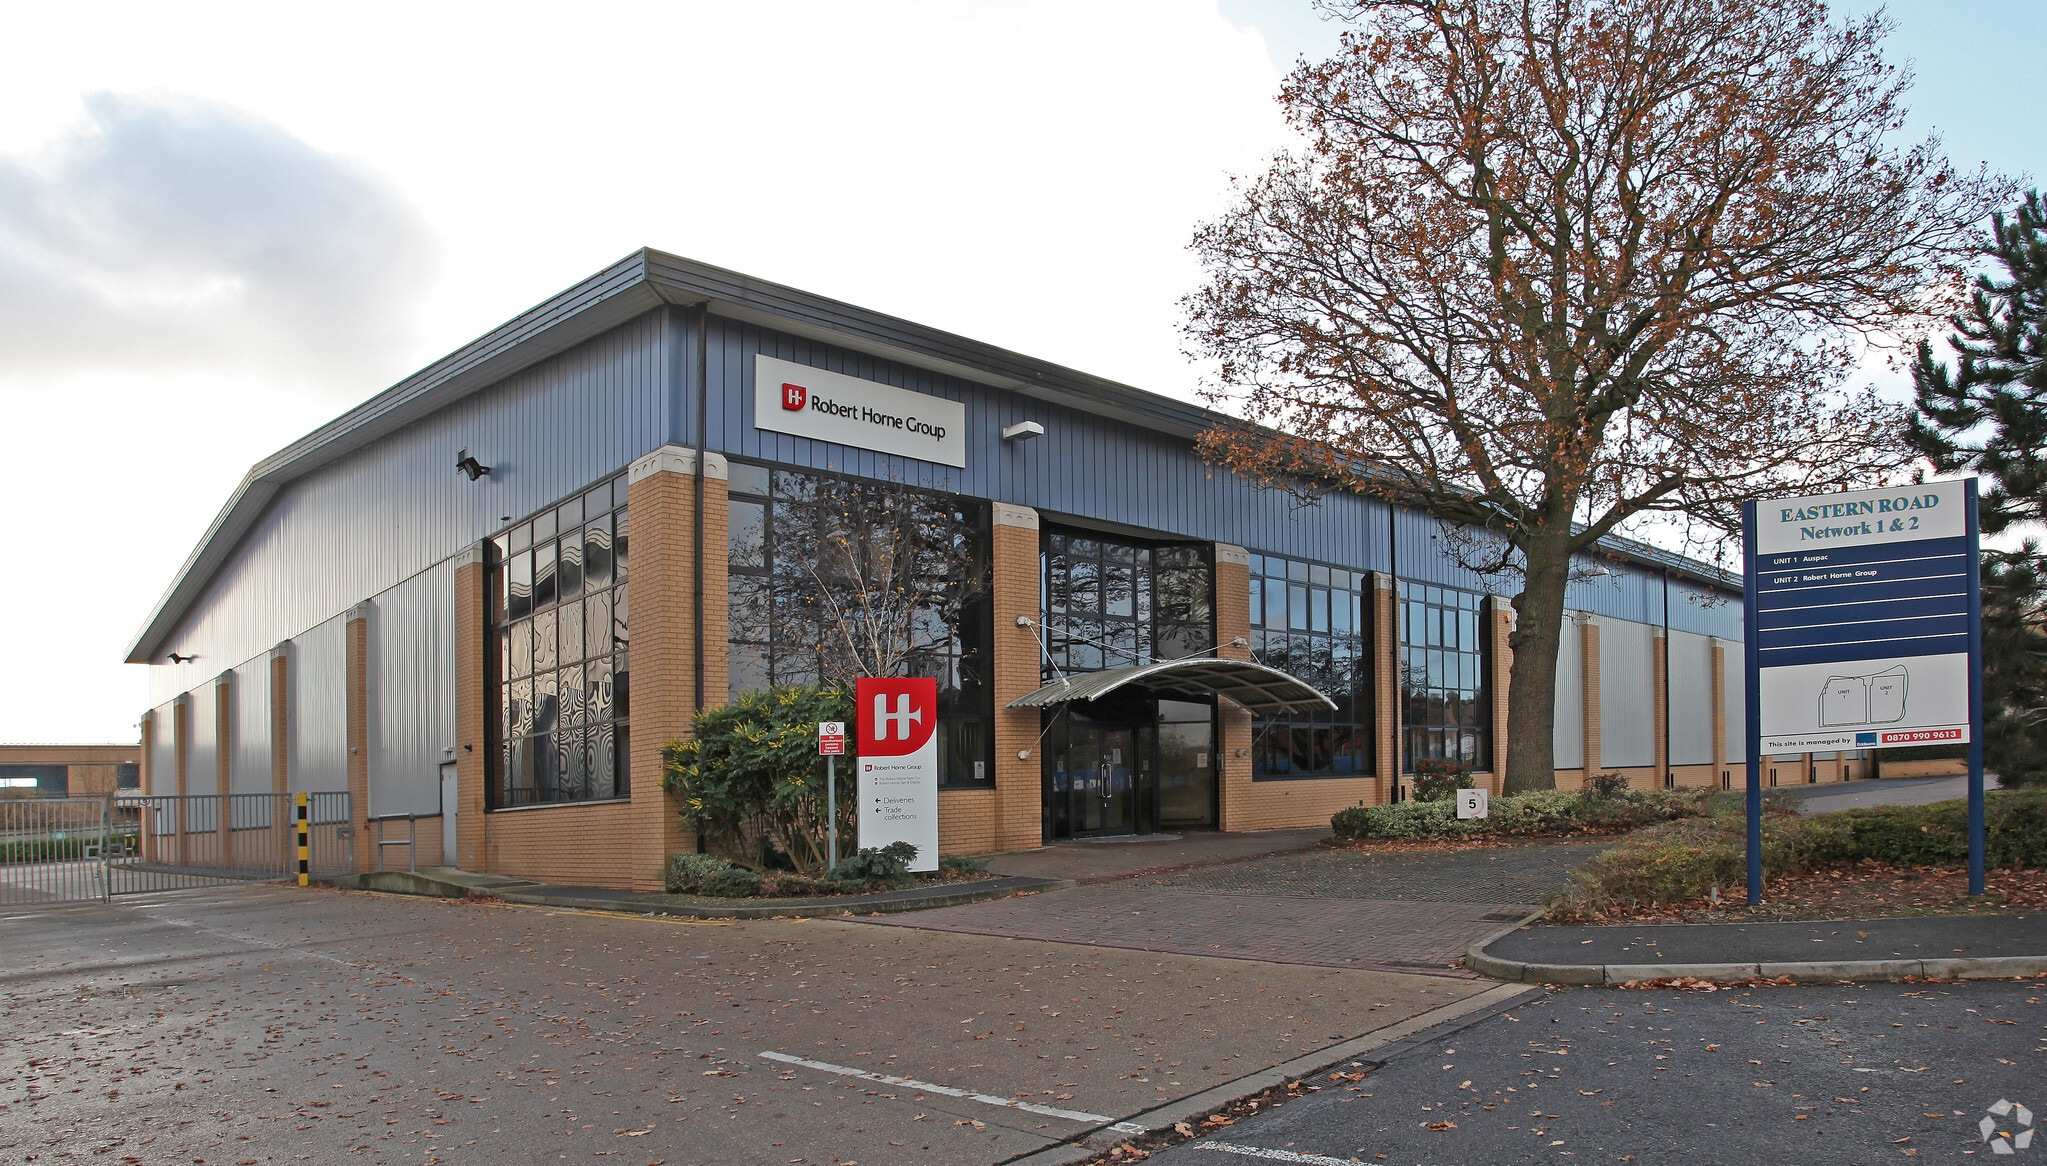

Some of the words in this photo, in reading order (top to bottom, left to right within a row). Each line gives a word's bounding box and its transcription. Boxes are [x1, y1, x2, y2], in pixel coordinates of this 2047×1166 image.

[811, 395, 858, 420] Robert
[862, 406, 903, 429] Horne
[906, 416, 946, 441] Group
[1780, 500, 1874, 523] EASTERN
[1878, 494, 1939, 513] ROAD
[1800, 521, 1872, 540] Network
[1876, 520, 1884, 533] 1
[1889, 517, 1904, 532] &
[1909, 516, 1919, 530] 2
[1773, 557, 1791, 565] UNIT
[1802, 555, 1828, 563] Auspac
[1773, 576, 1792, 584] UNIT
[1802, 574, 1827, 582] Robert
[1830, 571, 1852, 579] Horne
[1887, 733, 1910, 741] 0870
[1912, 732, 1930, 740] 990
[1932, 730, 1957, 738] 9613
[1468, 798, 1477, 809] 5
